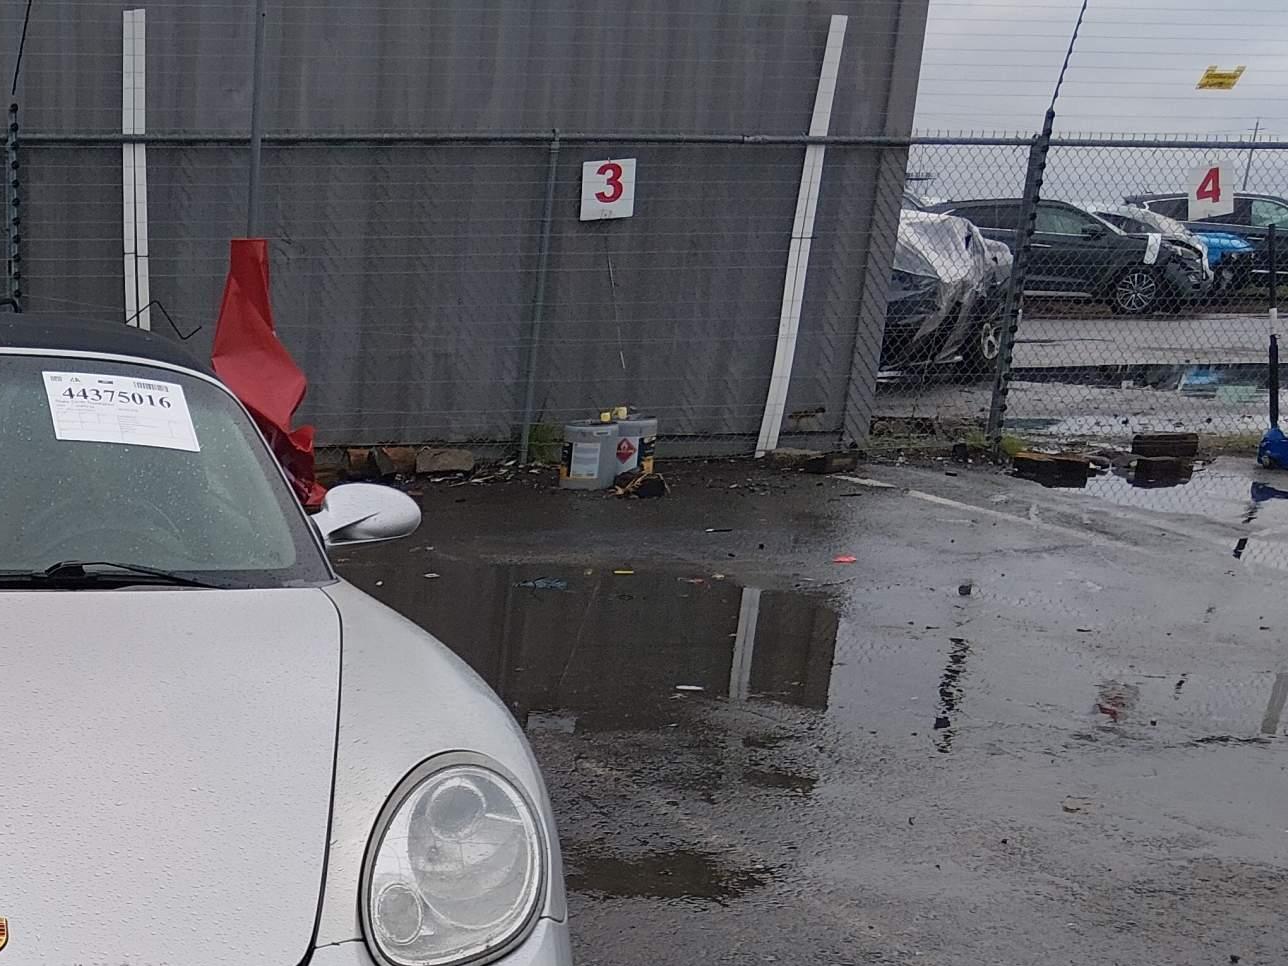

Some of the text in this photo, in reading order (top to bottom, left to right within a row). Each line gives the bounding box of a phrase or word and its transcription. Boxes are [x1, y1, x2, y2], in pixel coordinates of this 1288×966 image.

[595, 163, 623, 204] 3
[1196, 167, 1220, 203] 4
[62, 386, 172, 409] 44375016
